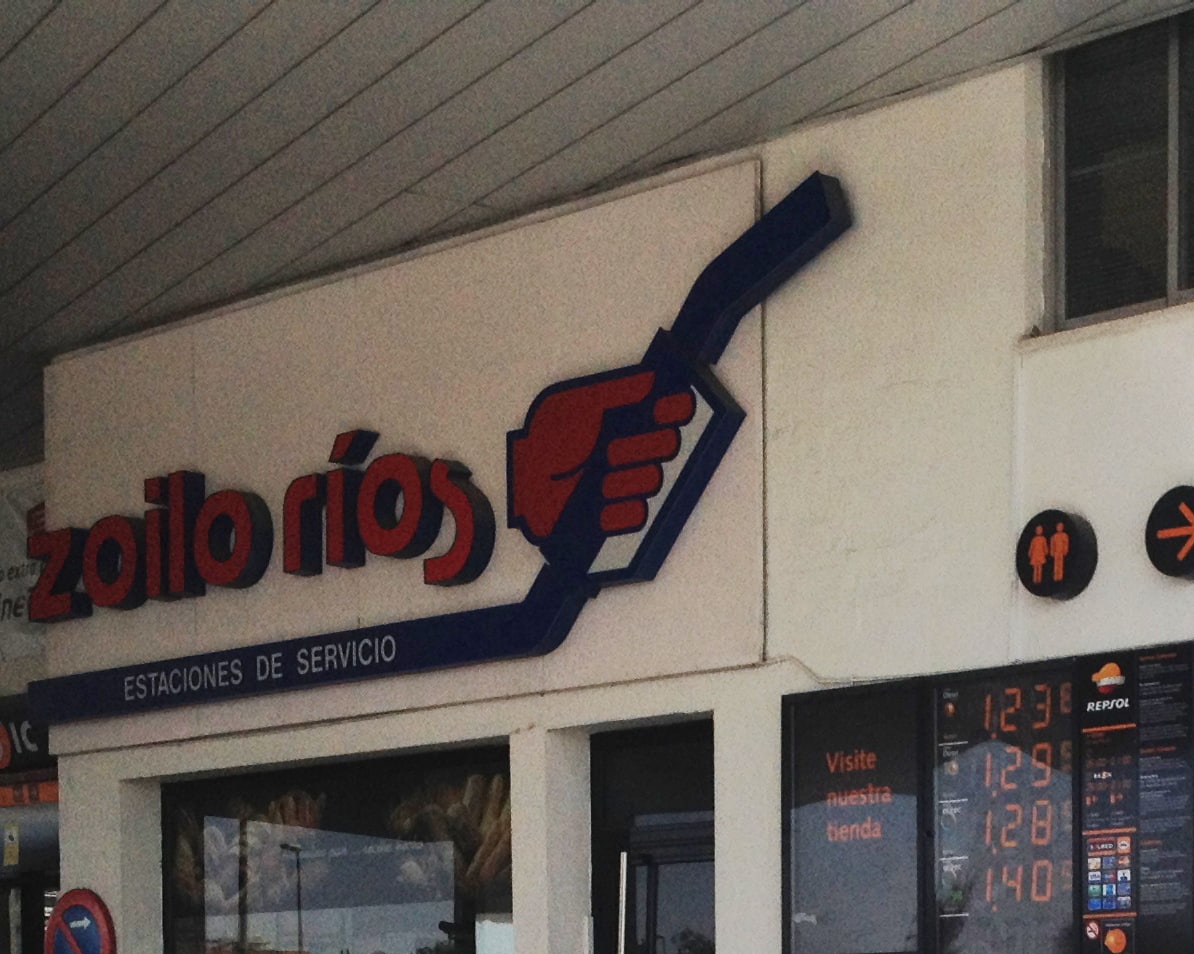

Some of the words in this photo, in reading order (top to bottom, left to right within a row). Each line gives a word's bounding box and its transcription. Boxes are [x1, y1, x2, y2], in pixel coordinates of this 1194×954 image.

[28, 470, 270, 622] zoilo
[283, 430, 495, 587] ríos
[124, 659, 243, 701] ESTACIONES
[256, 652, 283, 681] DE
[296, 635, 397, 675] SERVICIO
[1086, 698, 1130, 712] REPSOL
[826, 750, 878, 774] Visite
[826, 783, 893, 807] nuestra
[826, 816, 883, 842] tienda
